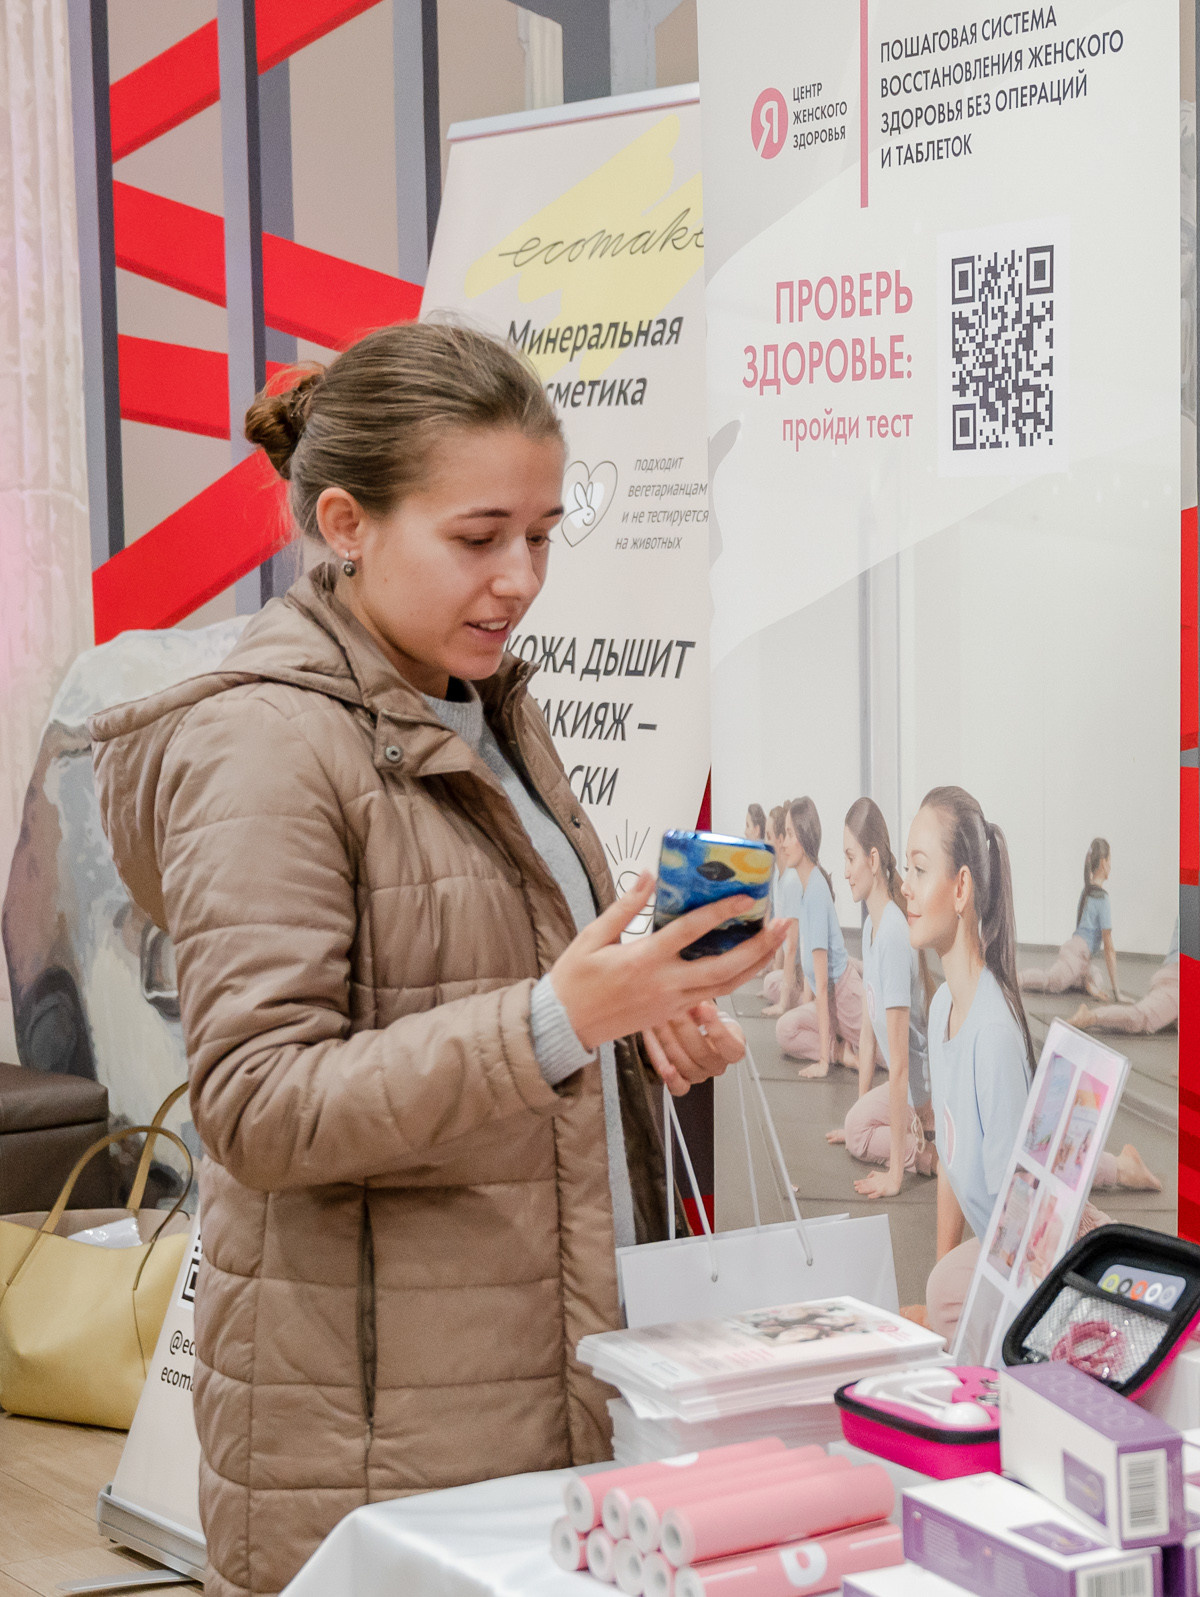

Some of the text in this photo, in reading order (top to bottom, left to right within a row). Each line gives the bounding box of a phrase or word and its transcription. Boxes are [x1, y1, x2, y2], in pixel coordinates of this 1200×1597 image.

[881, 5, 1057, 63] ПОШАГОВАЯ СИСТЕМА
[881, 29, 1124, 98] ВОССТАНОВЛЕНИЯ ЖЕНСКОГО
[793, 82, 823, 103] ЦЕНТР
[881, 68, 1088, 135] ЗДОРОВЬЯ БЕЗ ОПЕРАЦИЙ
[793, 101, 848, 125] ЖЕНСКОГО
[793, 125, 846, 150] ЗДОРОВЬЯ
[881, 133, 973, 169] И ТАБЛЕТОК
[776, 270, 913, 324] ПРОВЕРЬ
[508, 316, 684, 362] Минеральная
[742, 335, 912, 396] ЗДОРОВЬЕ:
[783, 408, 914, 452] пройди тест
[634, 457, 684, 473] подходит
[628, 482, 708, 499] вегетарианцам
[621, 509, 710, 527] и не тестируется
[615, 536, 683, 550] на животных
[579, 638, 697, 682] ДЫШИТ
[170, 1329, 196, 1356] @ec
